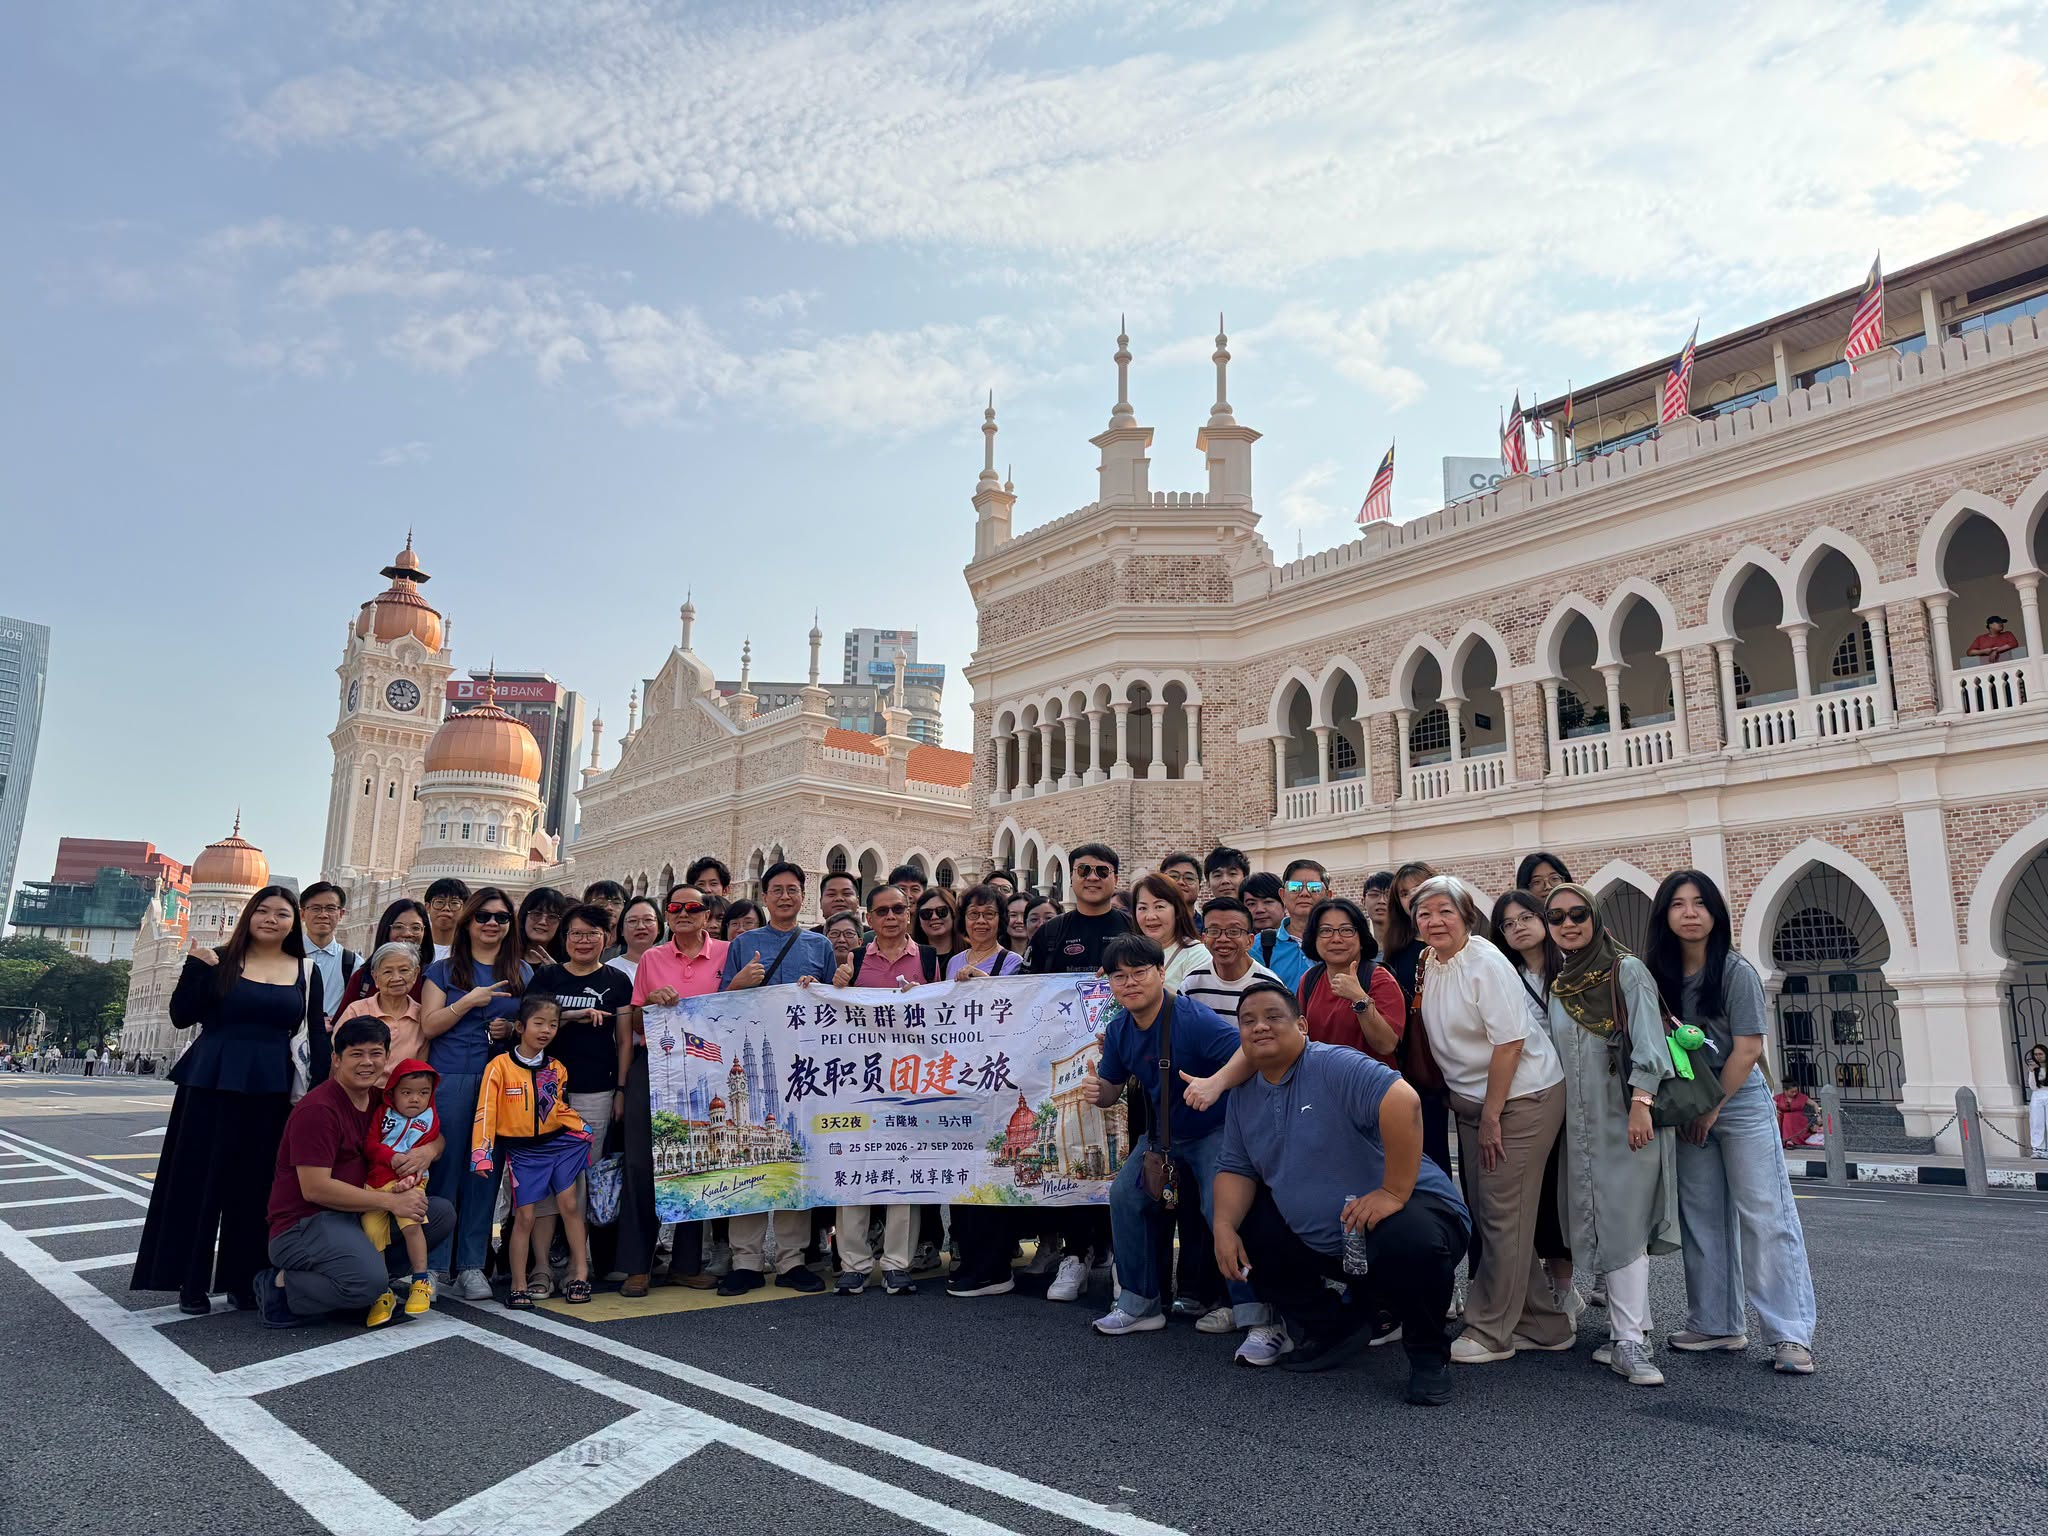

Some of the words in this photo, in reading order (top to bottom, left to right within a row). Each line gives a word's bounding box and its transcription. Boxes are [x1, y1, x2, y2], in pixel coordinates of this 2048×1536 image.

[476, 686, 508, 696] CMB
[511, 686, 544, 697] BANK
[786, 998, 1013, 1030] 笨珍培群独立中学
[821, 1033, 843, 1045] PEI
[848, 1032, 887, 1045] CHUN
[892, 1033, 926, 1045] HIGH
[931, 1031, 985, 1045] SCHOOL
[785, 1050, 1018, 1102] 教职员团建之旅
[821, 1115, 862, 1129] 3天2夜
[885, 1114, 918, 1128] 吉隆坡
[938, 1115, 972, 1128] 马六甲
[849, 1143, 861, 1153] 25
[864, 1143, 882, 1152] SEP
[885, 1142, 907, 1151] 2026
[917, 1142, 928, 1151] 27
[931, 1142, 948, 1151] SEP
[951, 1142, 974, 1151] 2026
[701, 1181, 729, 1200] Kuala
[733, 1174, 767, 1190] Lumpur
[1042, 1178, 1080, 1195] Melaka
